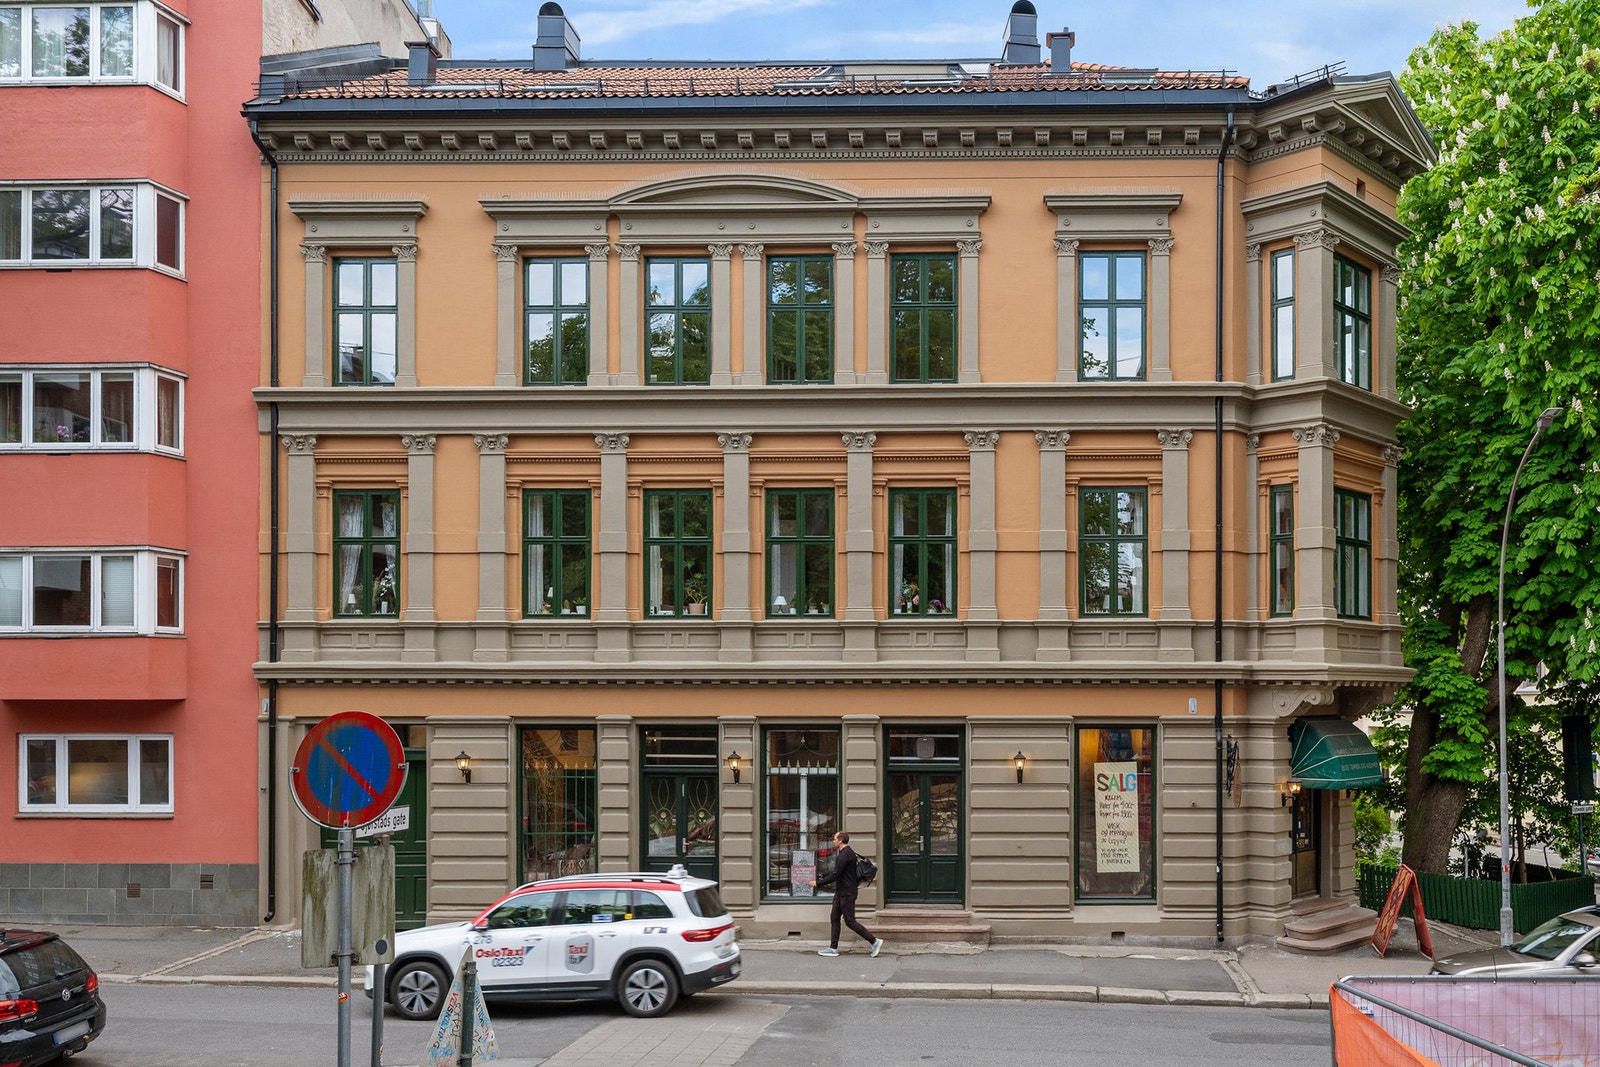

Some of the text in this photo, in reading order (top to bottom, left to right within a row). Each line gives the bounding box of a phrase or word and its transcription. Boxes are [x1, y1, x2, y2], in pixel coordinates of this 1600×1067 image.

[393, 813, 406, 829] gate
[474, 935, 492, 944] 278
[476, 946, 524, 958] OsloTaxi
[568, 942, 589, 954] Taxi
[492, 957, 524, 968] 02323
